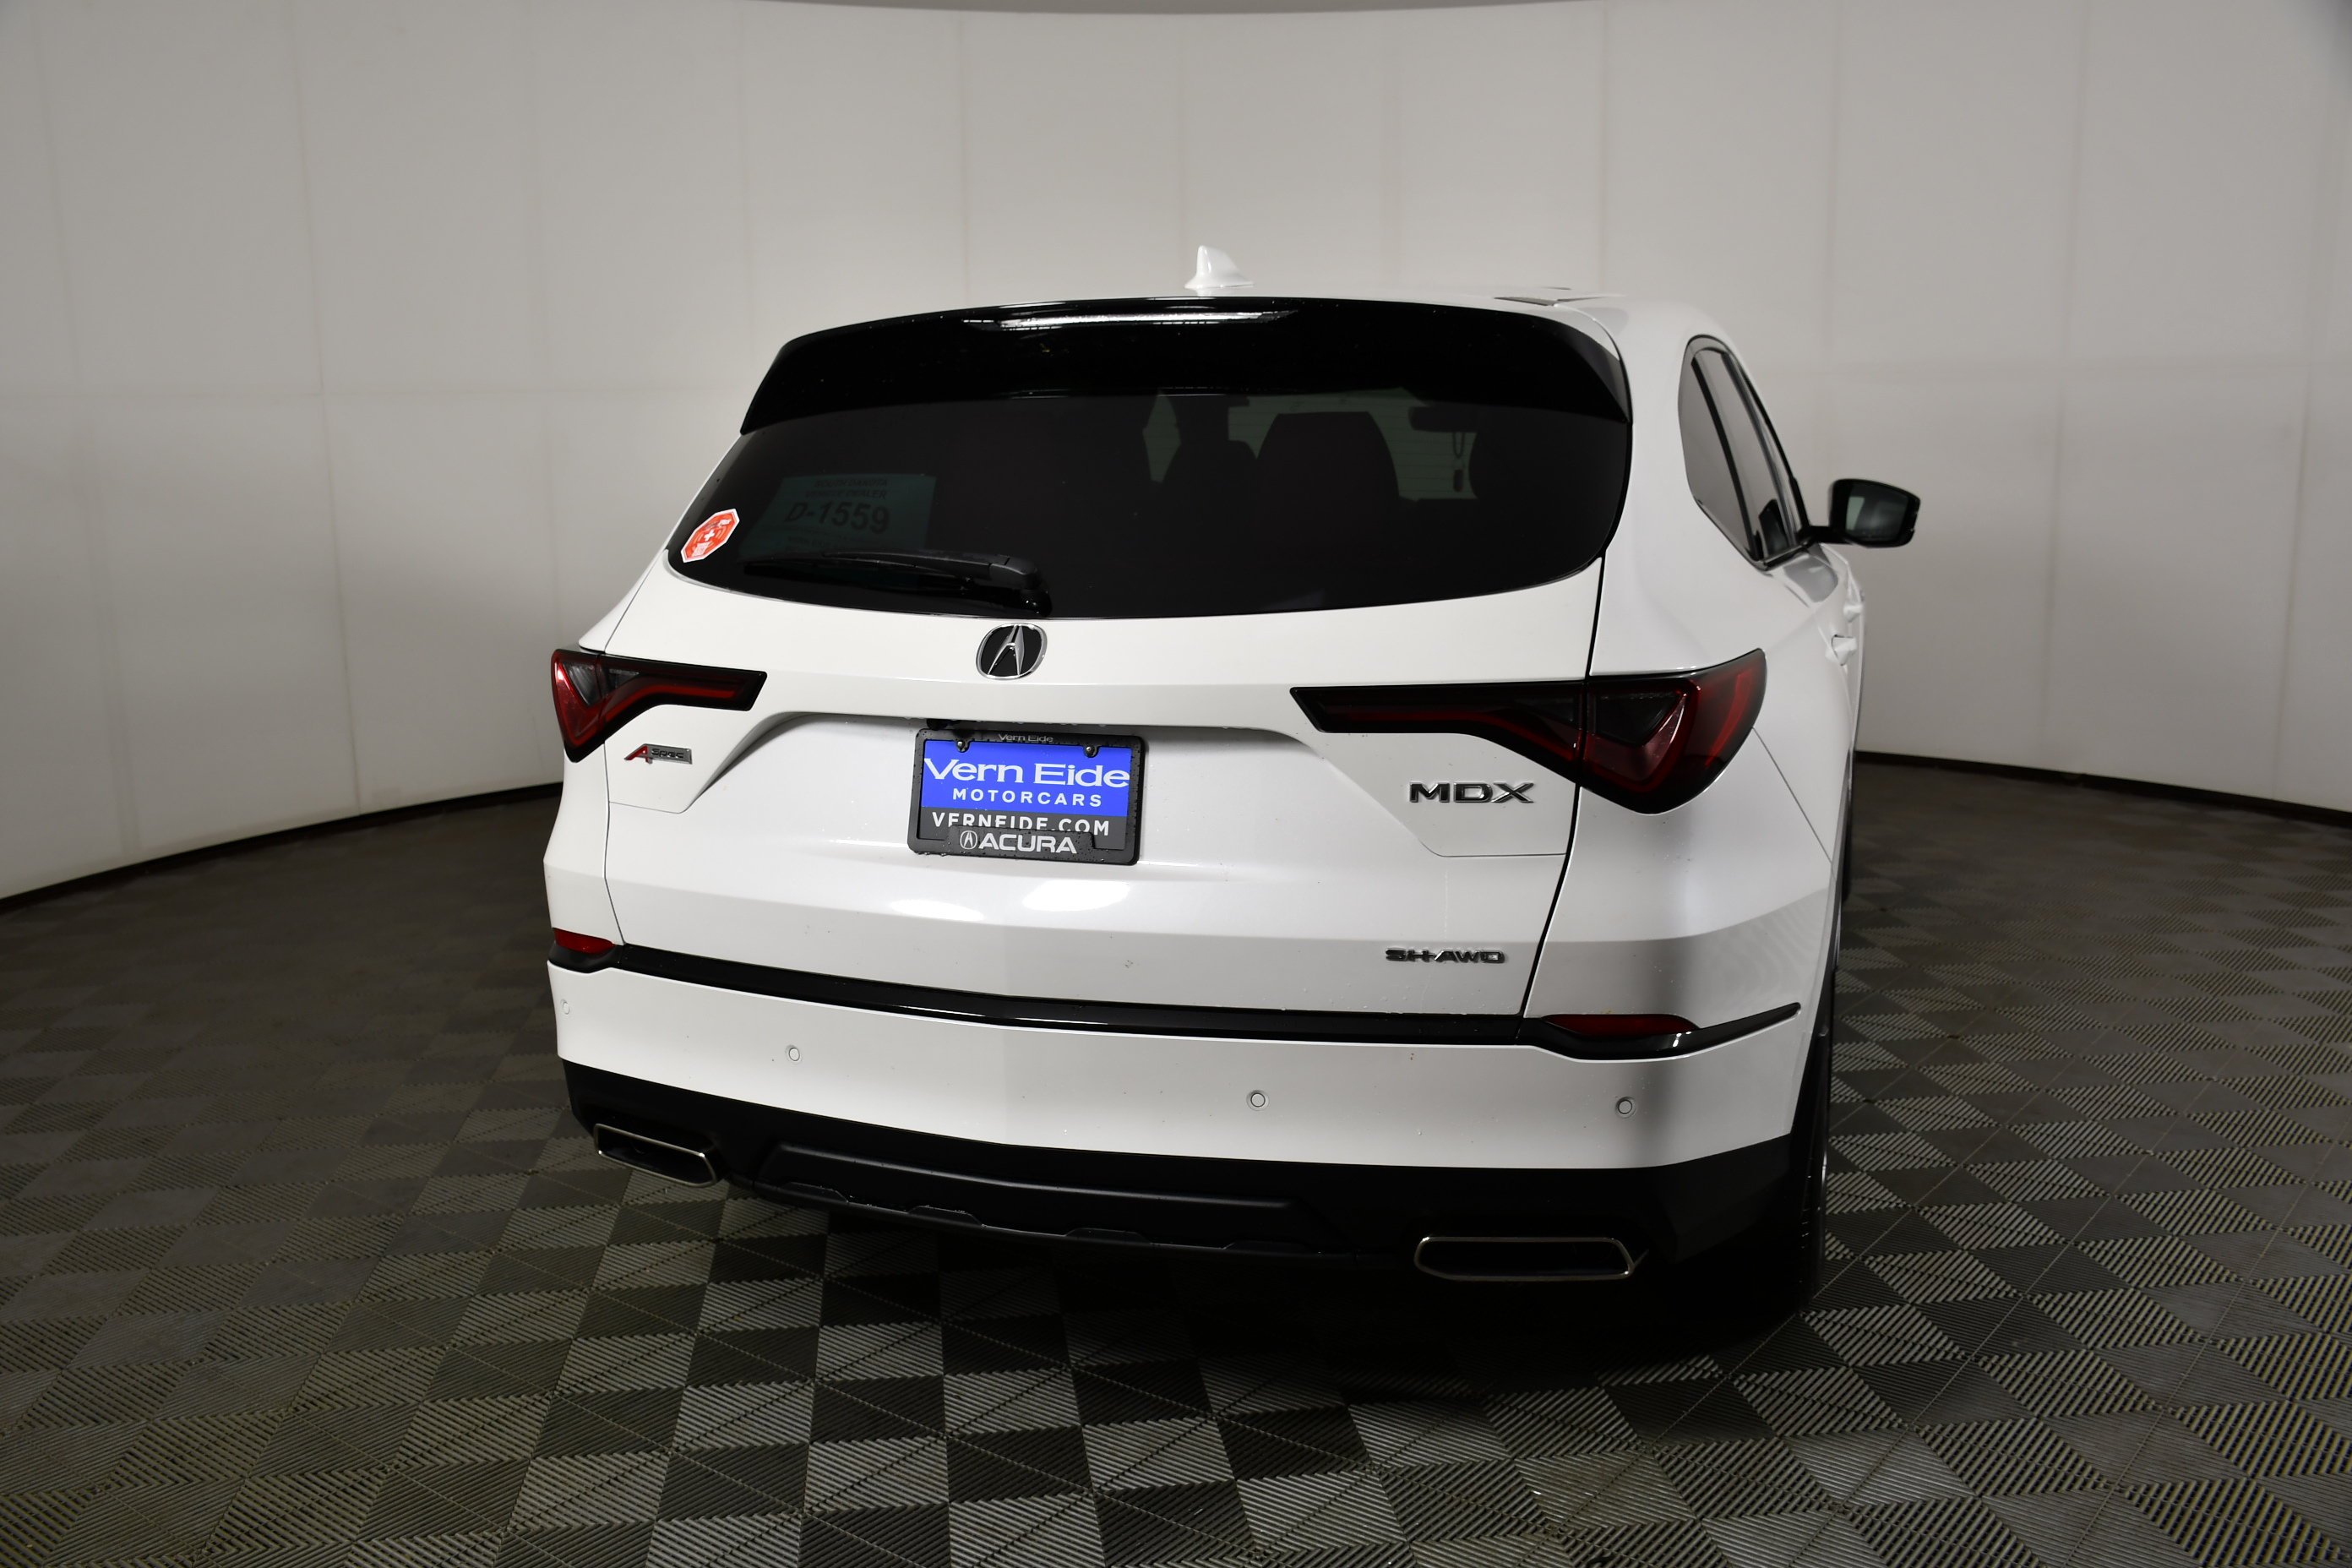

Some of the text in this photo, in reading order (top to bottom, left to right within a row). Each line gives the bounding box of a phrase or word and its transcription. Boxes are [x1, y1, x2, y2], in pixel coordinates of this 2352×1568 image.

[846, 489, 887, 499] DEALER
[784, 500, 890, 535] D-1559
[998, 733, 1054, 743] Vern Eide
[924, 758, 1130, 788] Vern Eide
[952, 787, 1102, 808] MOTORCARS
[1409, 782, 1535, 803] MDX
[977, 832, 1078, 854] ACURA
